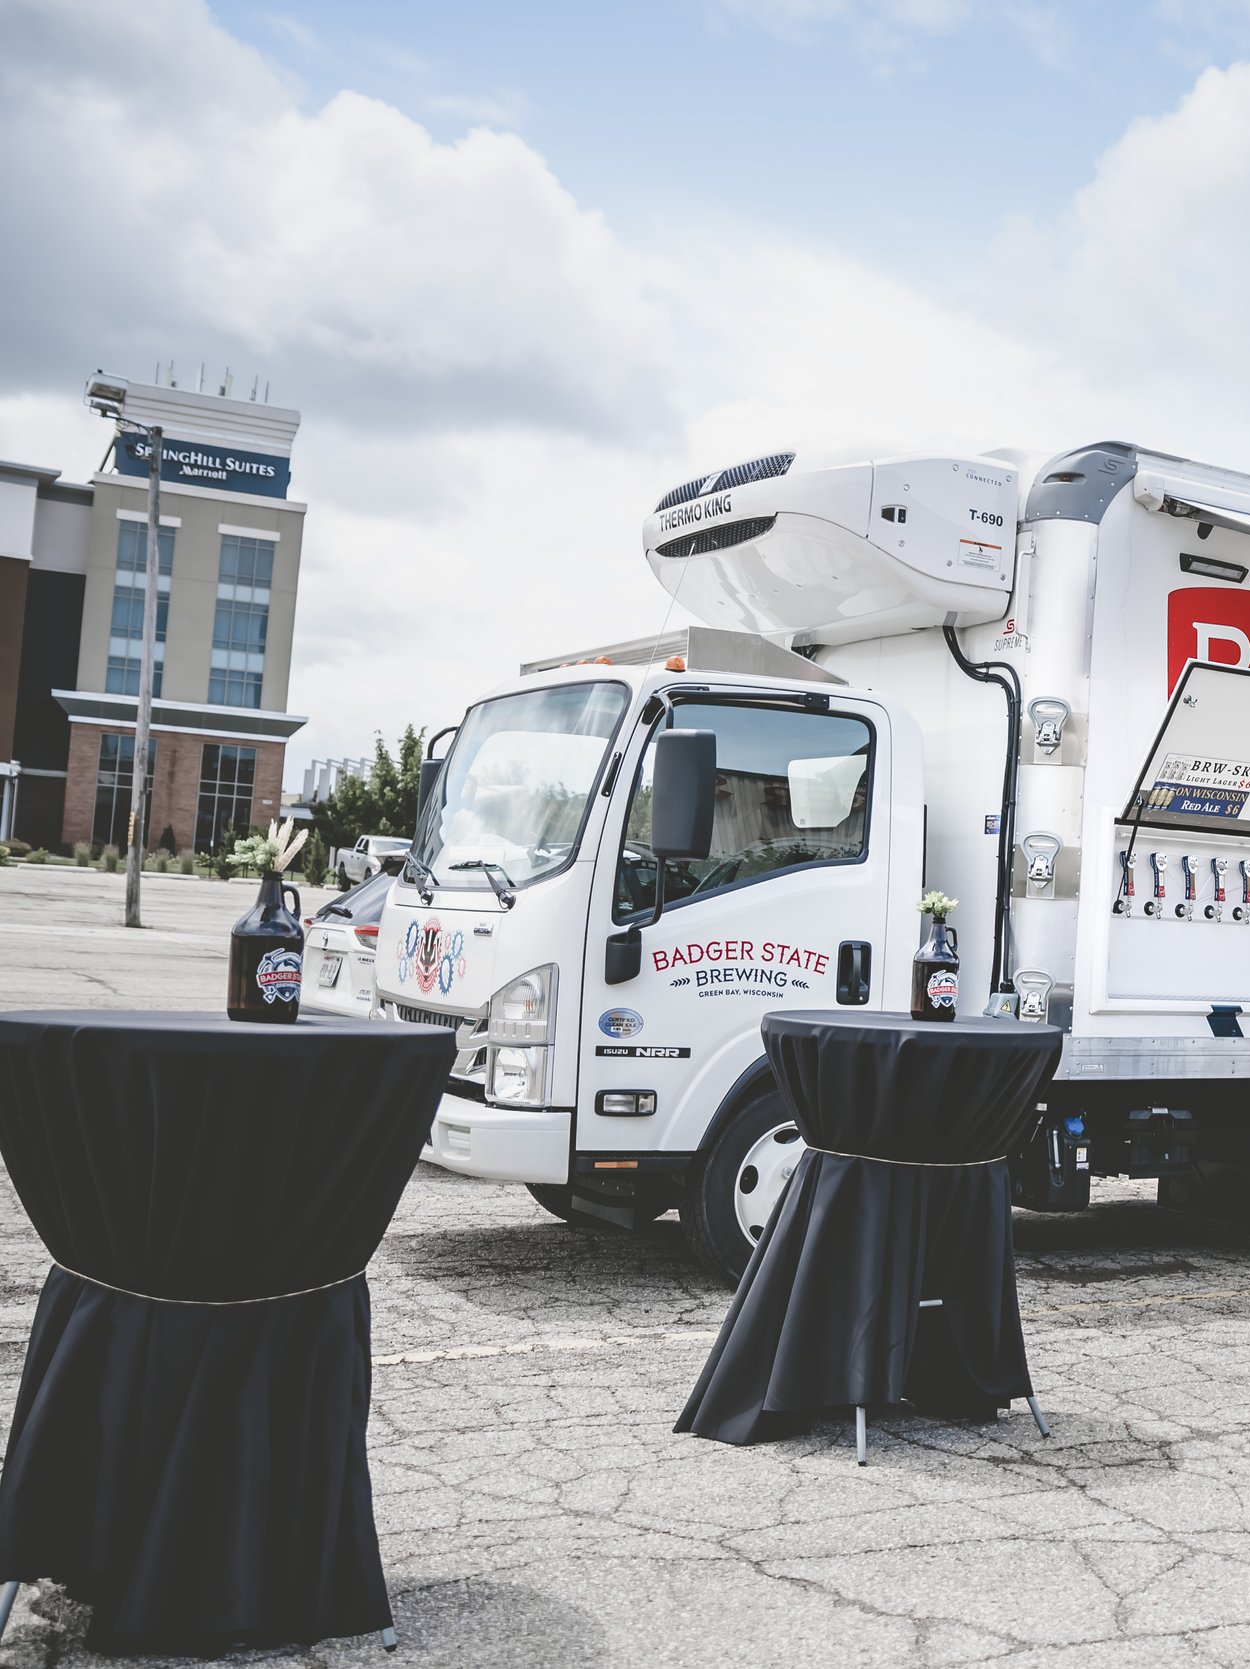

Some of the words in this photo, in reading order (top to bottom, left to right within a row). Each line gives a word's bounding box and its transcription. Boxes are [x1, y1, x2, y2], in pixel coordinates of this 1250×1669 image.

[135, 443, 222, 468] SPINGHILL
[179, 465, 227, 480] Marriott
[966, 473, 1003, 487] CONNECTED
[660, 503, 702, 532] THERMO
[704, 494, 732, 519] KING
[969, 509, 1004, 527] T-690
[994, 635, 1023, 652] SUPREME
[1175, 786, 1190, 797] ON
[1192, 788, 1249, 803] WISCONSIN
[1225, 804, 1240, 815] $6
[652, 941, 754, 971] BADGER
[761, 943, 830, 975] STATE
[260, 973, 292, 982] BADGER
[695, 968, 788, 987] BREWING
[699, 989, 723, 998] GREEN
[743, 989, 784, 998] WISCONSIN
[636, 1048, 680, 1057] NRR
